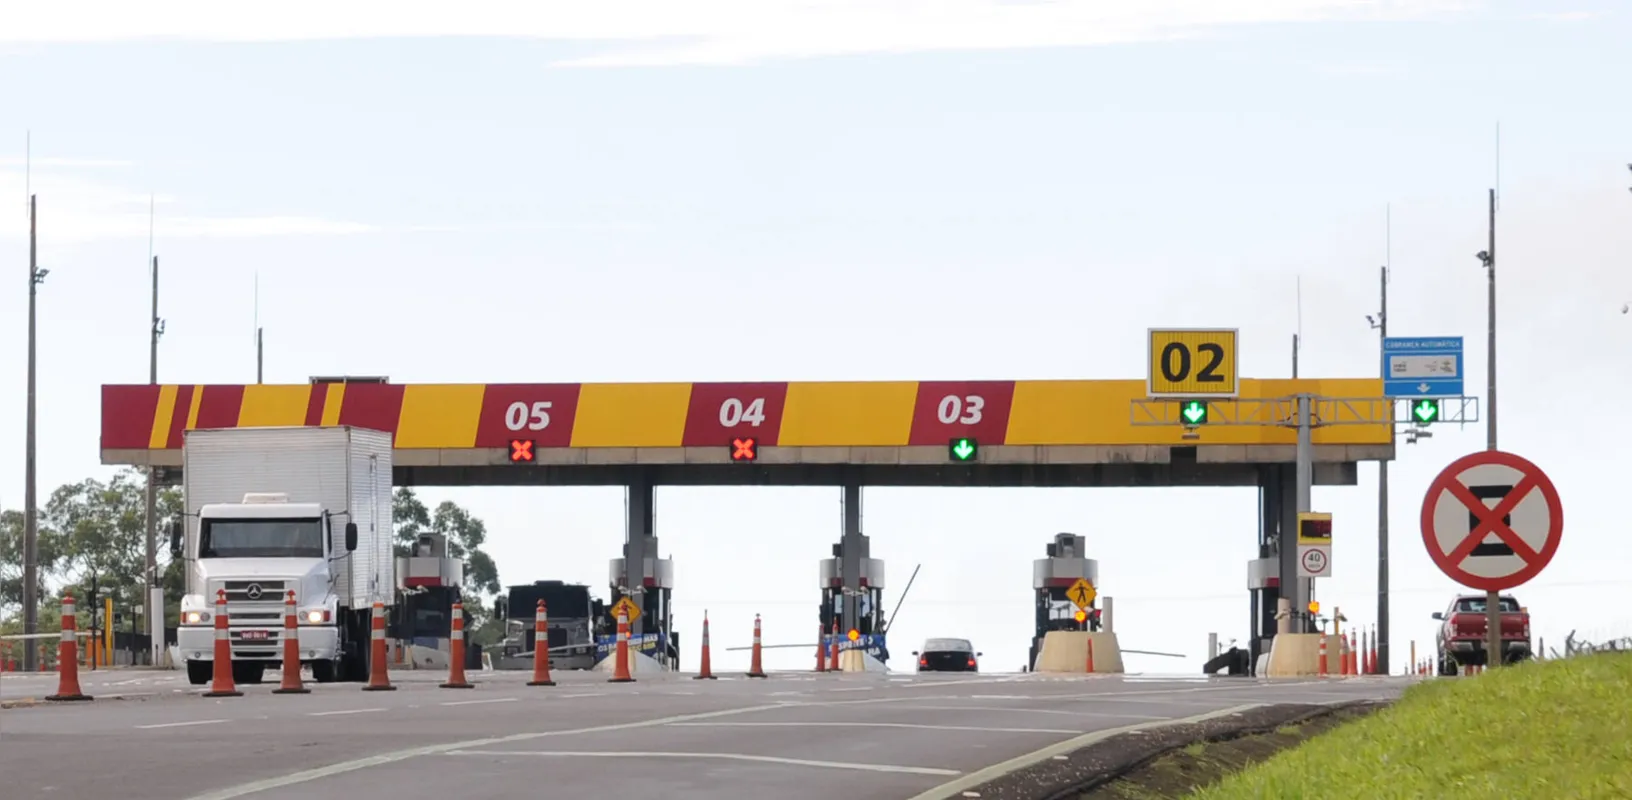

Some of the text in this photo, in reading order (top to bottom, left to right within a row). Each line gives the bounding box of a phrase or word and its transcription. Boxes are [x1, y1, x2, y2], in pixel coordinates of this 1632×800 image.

[1161, 342, 1225, 382] 02
[505, 401, 552, 431] 05
[719, 397, 766, 427] 04
[937, 394, 985, 425] 03
[1308, 553, 1321, 562] 40
